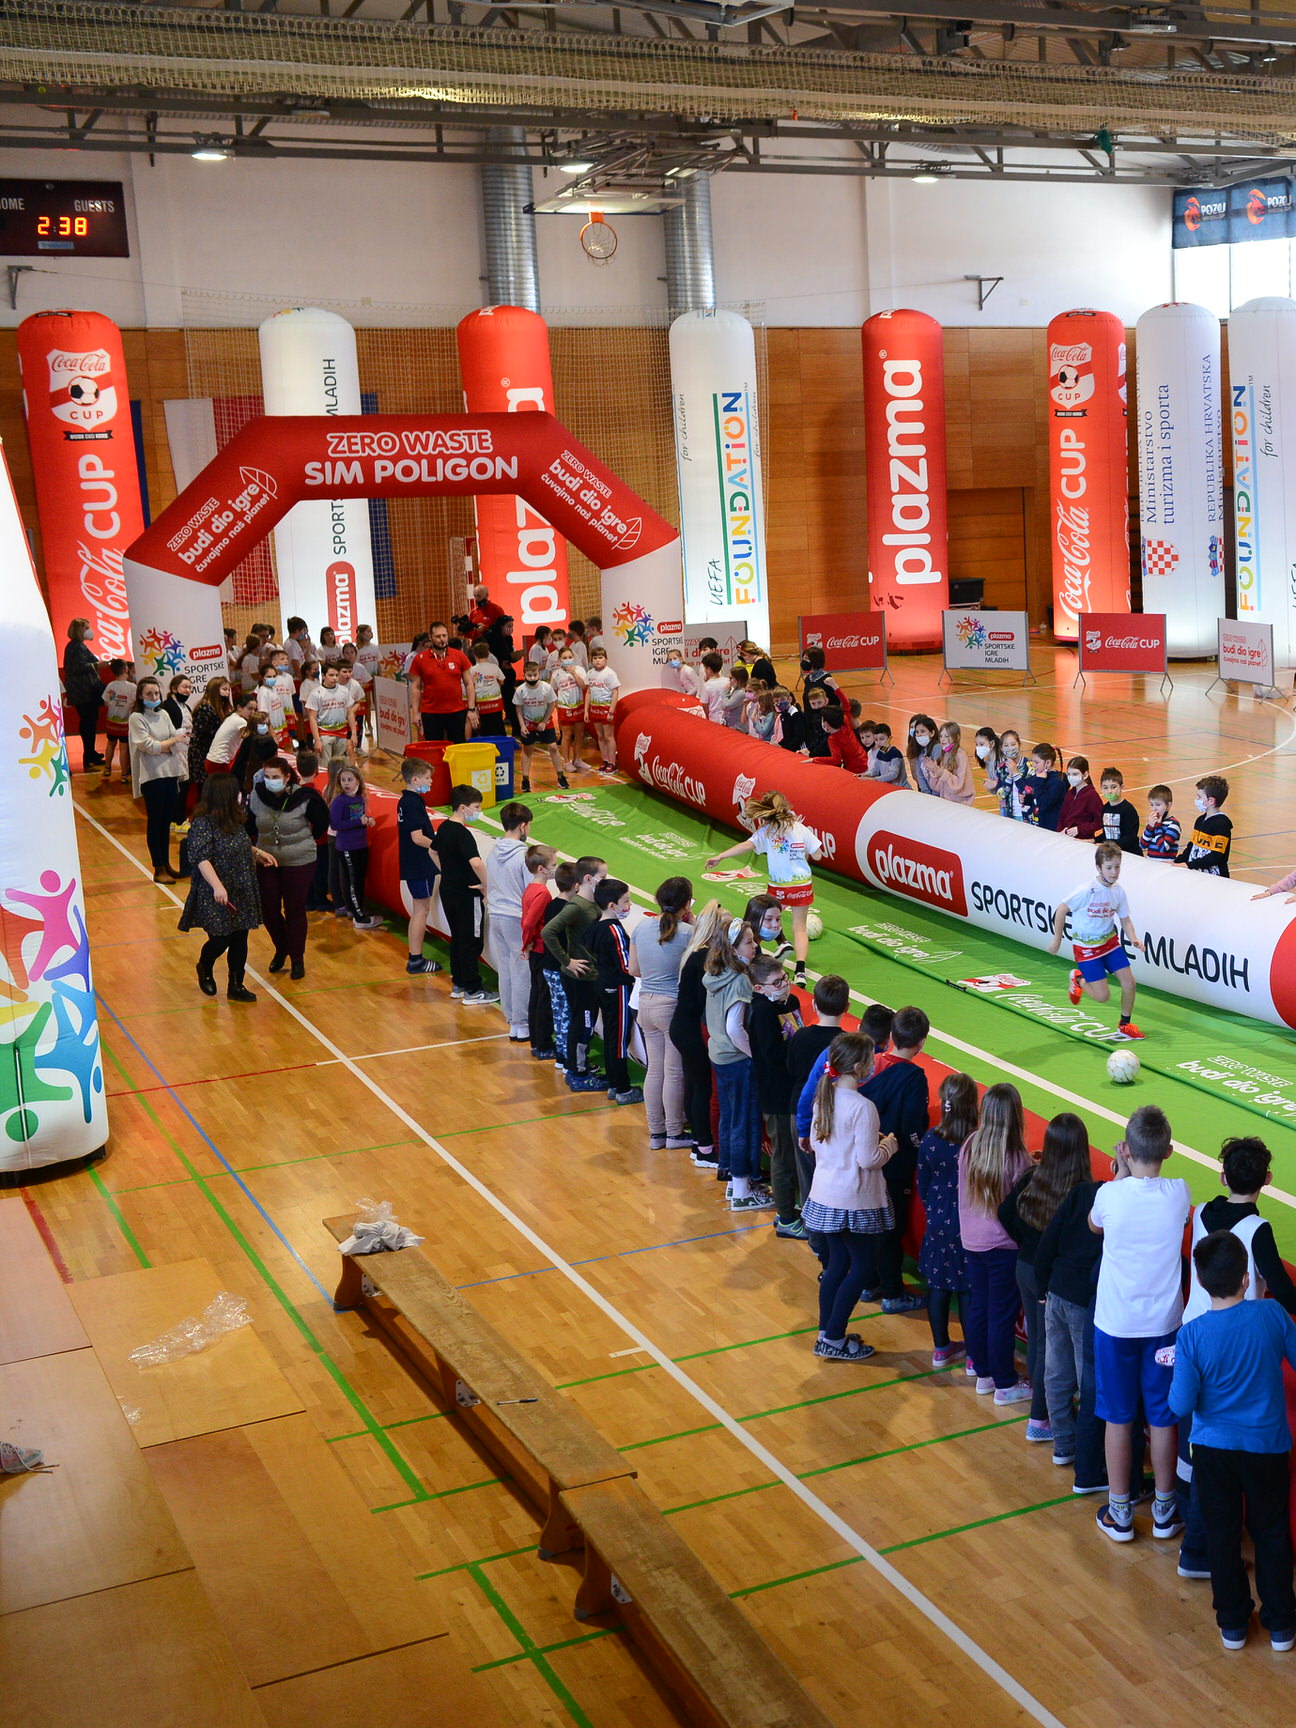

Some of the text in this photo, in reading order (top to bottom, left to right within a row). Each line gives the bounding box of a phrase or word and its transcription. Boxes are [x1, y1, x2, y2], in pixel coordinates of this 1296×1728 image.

[0, 197, 25, 210] OME
[74, 199, 115, 213] GUESTS
[1201, 202, 1226, 215] POZOJ
[1267, 195, 1292, 208] POZOJ
[52, 353, 107, 372] Coca-Cola
[1051, 345, 1088, 362] Coca-Cola
[70, 410, 104, 420] CUP
[1058, 392, 1081, 401] CUP
[1158, 384, 1175, 441] sporta
[1256, 384, 1278, 457] for children
[327, 429, 493, 457] ZERO WASTE
[678, 392, 692, 461] for children
[1202, 354, 1216, 522] REPUBLIKA HRVATSKA
[304, 456, 518, 485] SIM POLIGON
[560, 450, 612, 498] ZERO WASTE
[882, 360, 942, 585] plazma
[1060, 428, 1087, 499] CUP
[1145, 410, 1157, 524] Ministarstvo
[1159, 456, 1175, 525] turizma
[78, 454, 120, 539] CUP
[167, 496, 220, 552] ZERO WASTE
[178, 482, 260, 565] budi dio igre
[541, 472, 618, 545] čuvajmo naš planet
[549, 458, 628, 535] budi dio igre
[721, 392, 757, 605] FOUNDATION
[1232, 385, 1255, 611] FOUNDATION
[194, 493, 271, 573] čuvajmo naš planet
[1056, 499, 1091, 622] Coca-Cola
[705, 557, 723, 606] UEFA
[334, 573, 352, 648] plazma
[192, 647, 220, 660] plazma
[860, 636, 880, 647] CUP
[1139, 639, 1160, 649] CUP
[684, 775, 706, 807] CUP
[875, 843, 954, 901] plazma
[1144, 931, 1250, 992] MLADIH
[1176, 1060, 1235, 1080] budi
[1222, 1079, 1260, 1094] dio
